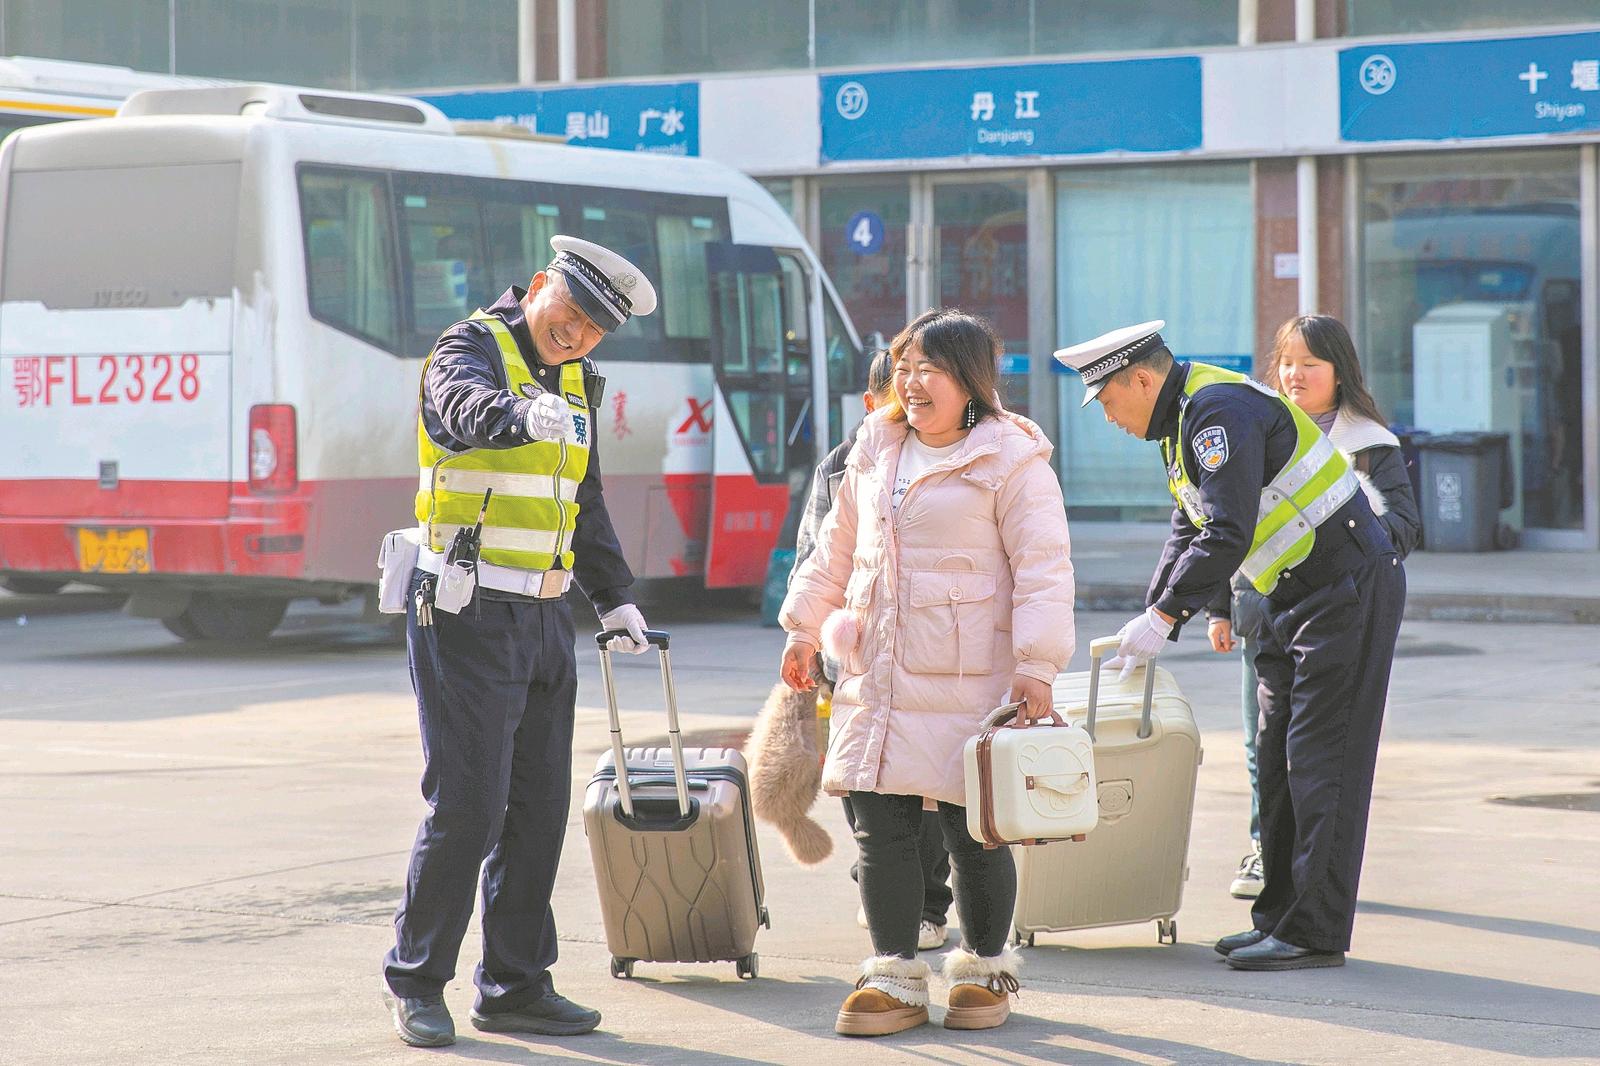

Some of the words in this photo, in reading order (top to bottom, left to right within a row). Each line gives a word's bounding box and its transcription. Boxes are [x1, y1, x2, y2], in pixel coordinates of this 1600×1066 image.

[1518, 59, 1600, 95] 十堰
[970, 91, 1040, 121] 丹江
[1535, 101, 1585, 122] Shiyan
[566, 111, 609, 140] 吴山
[638, 107, 685, 137] 广水
[977, 128, 1035, 146] Danjiang
[852, 217, 873, 248] 4
[15, 355, 200, 406] 鄂FL2328
